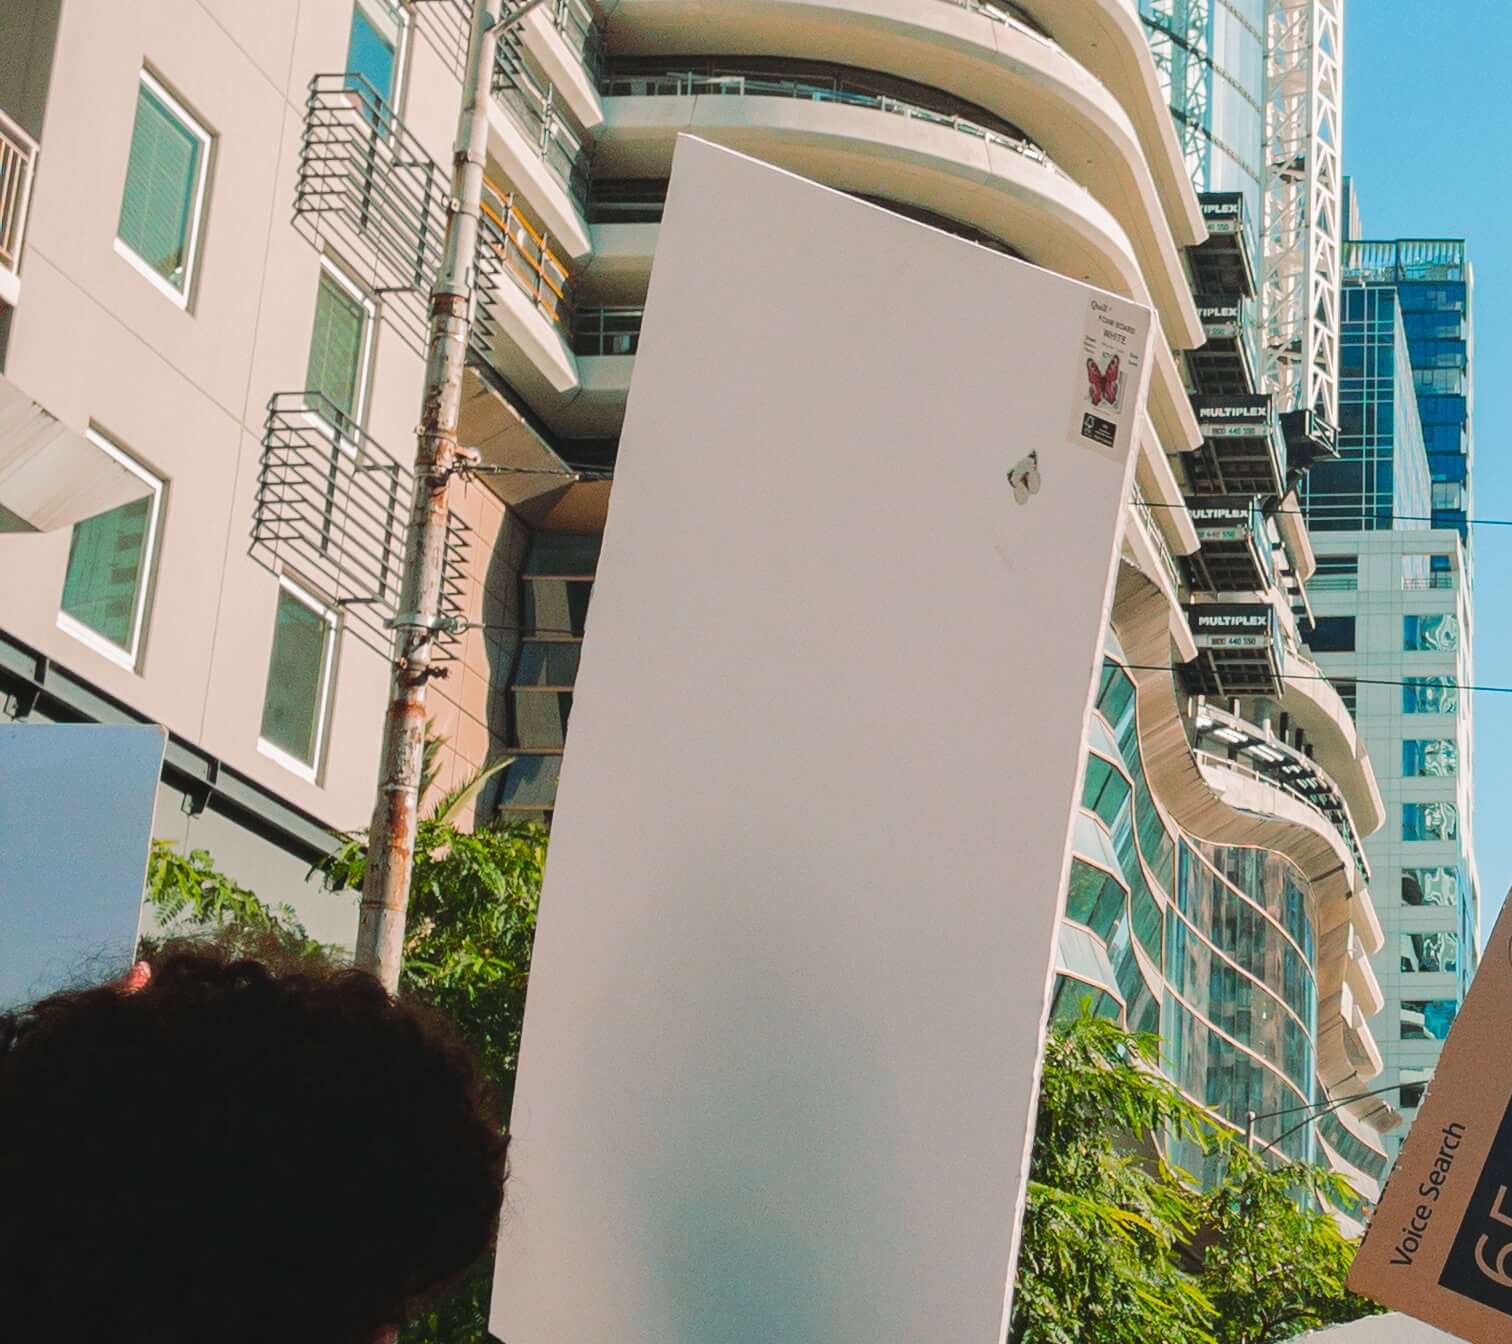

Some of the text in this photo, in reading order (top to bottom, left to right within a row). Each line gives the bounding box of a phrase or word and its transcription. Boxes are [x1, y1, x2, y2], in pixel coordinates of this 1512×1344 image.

[1103, 329, 1127, 345] WHITE
[1200, 407, 1266, 417] MULTIPLEX
[1199, 616, 1266, 626] MULTIPLEX
[1390, 1121, 1466, 1265] Voice Search
